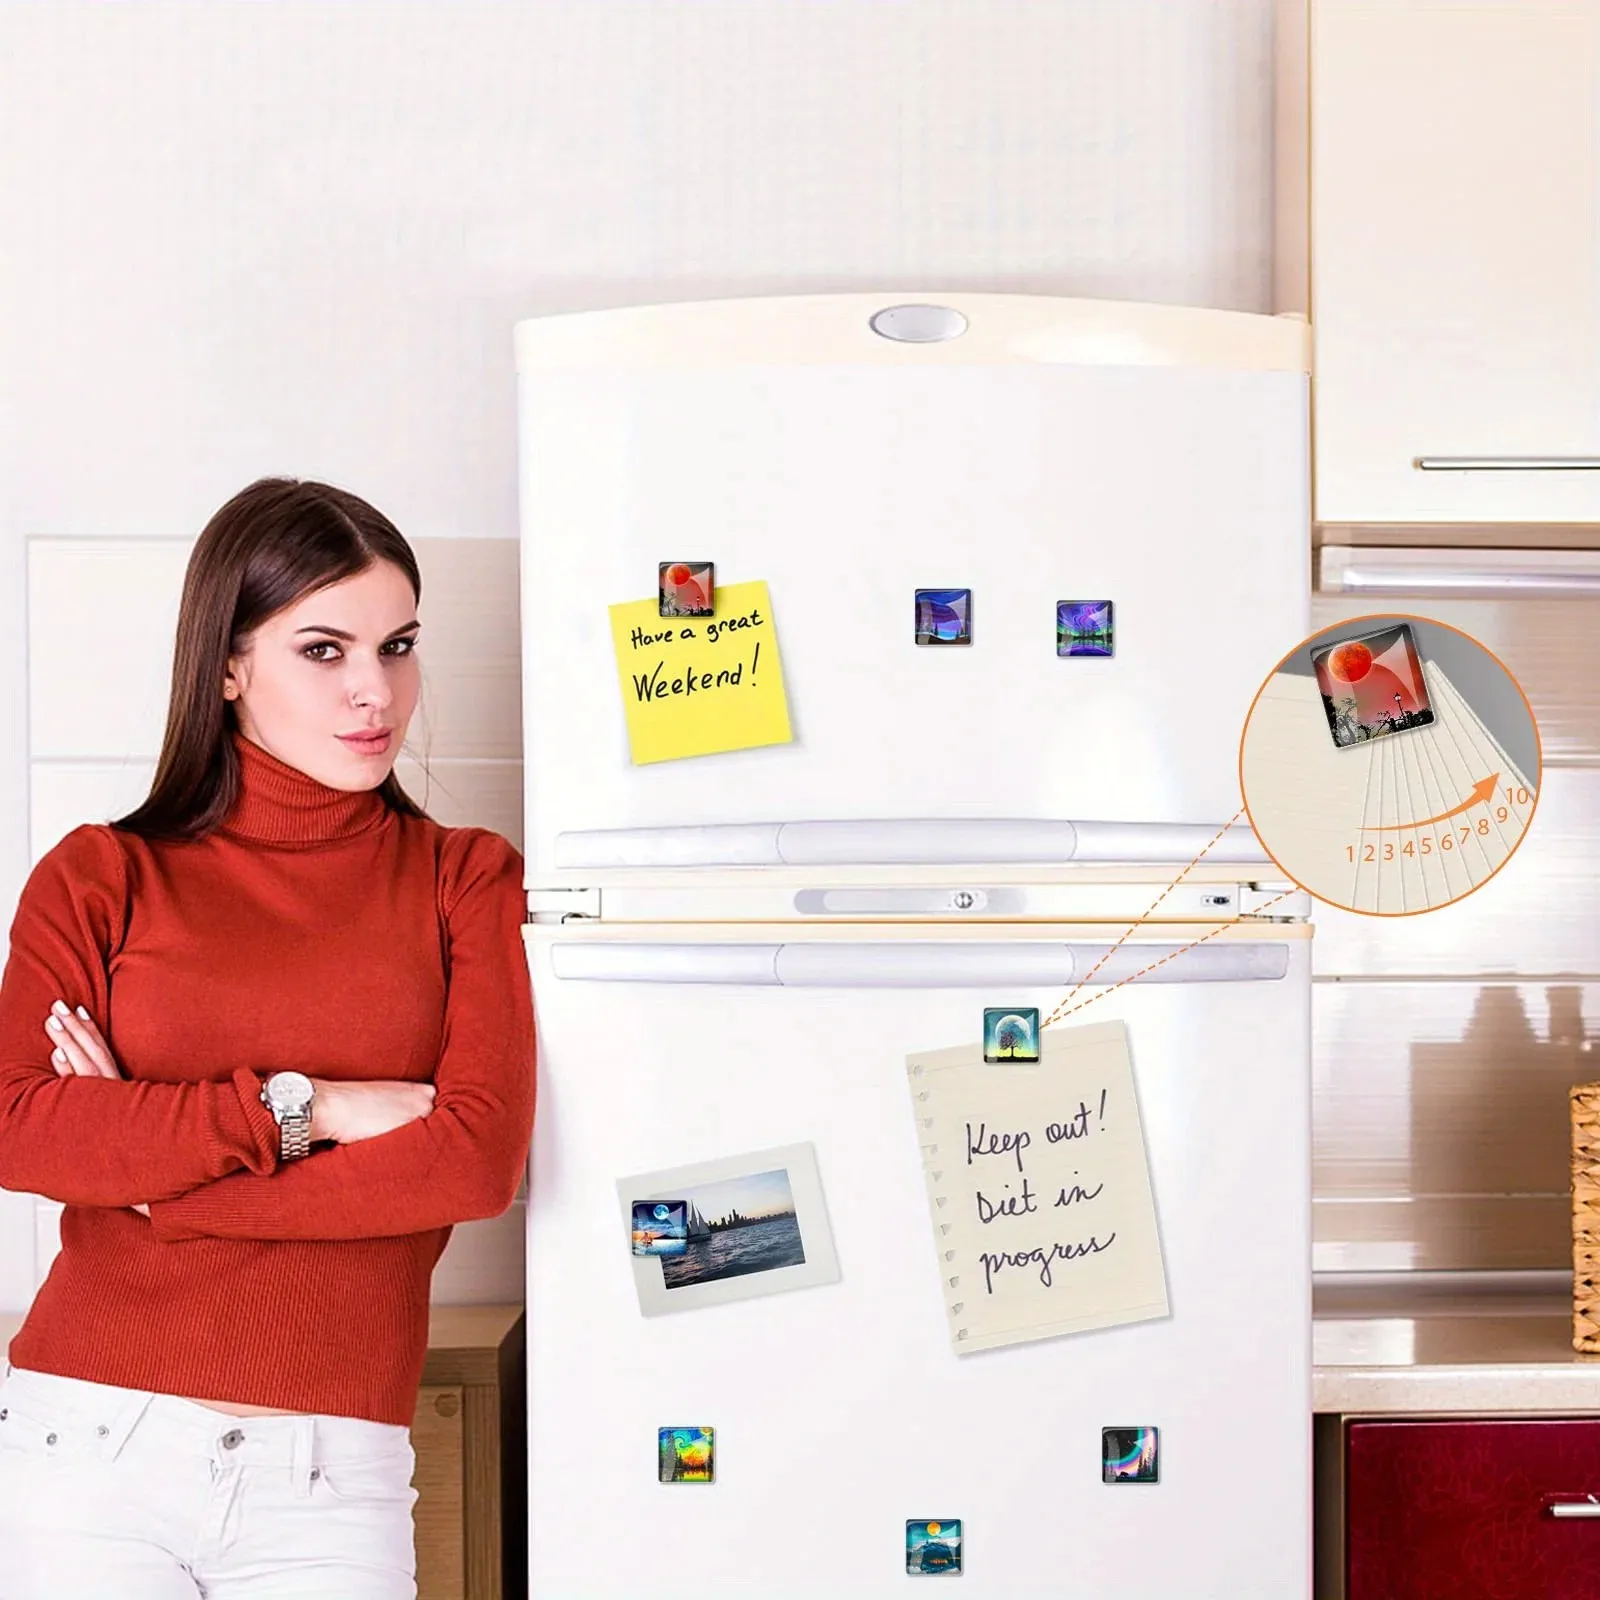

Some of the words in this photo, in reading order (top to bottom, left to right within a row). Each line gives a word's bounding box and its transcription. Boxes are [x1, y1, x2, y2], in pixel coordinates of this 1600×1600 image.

[631, 627, 673, 649] Have
[680, 628, 696, 639] a
[707, 610, 763, 642] great
[966, 1122, 1031, 1172] Keep
[1045, 1088, 1107, 1144] out!
[976, 1178, 1037, 1224] Diet
[1053, 1170, 1104, 1208] in
[979, 1232, 1116, 1295] progress
